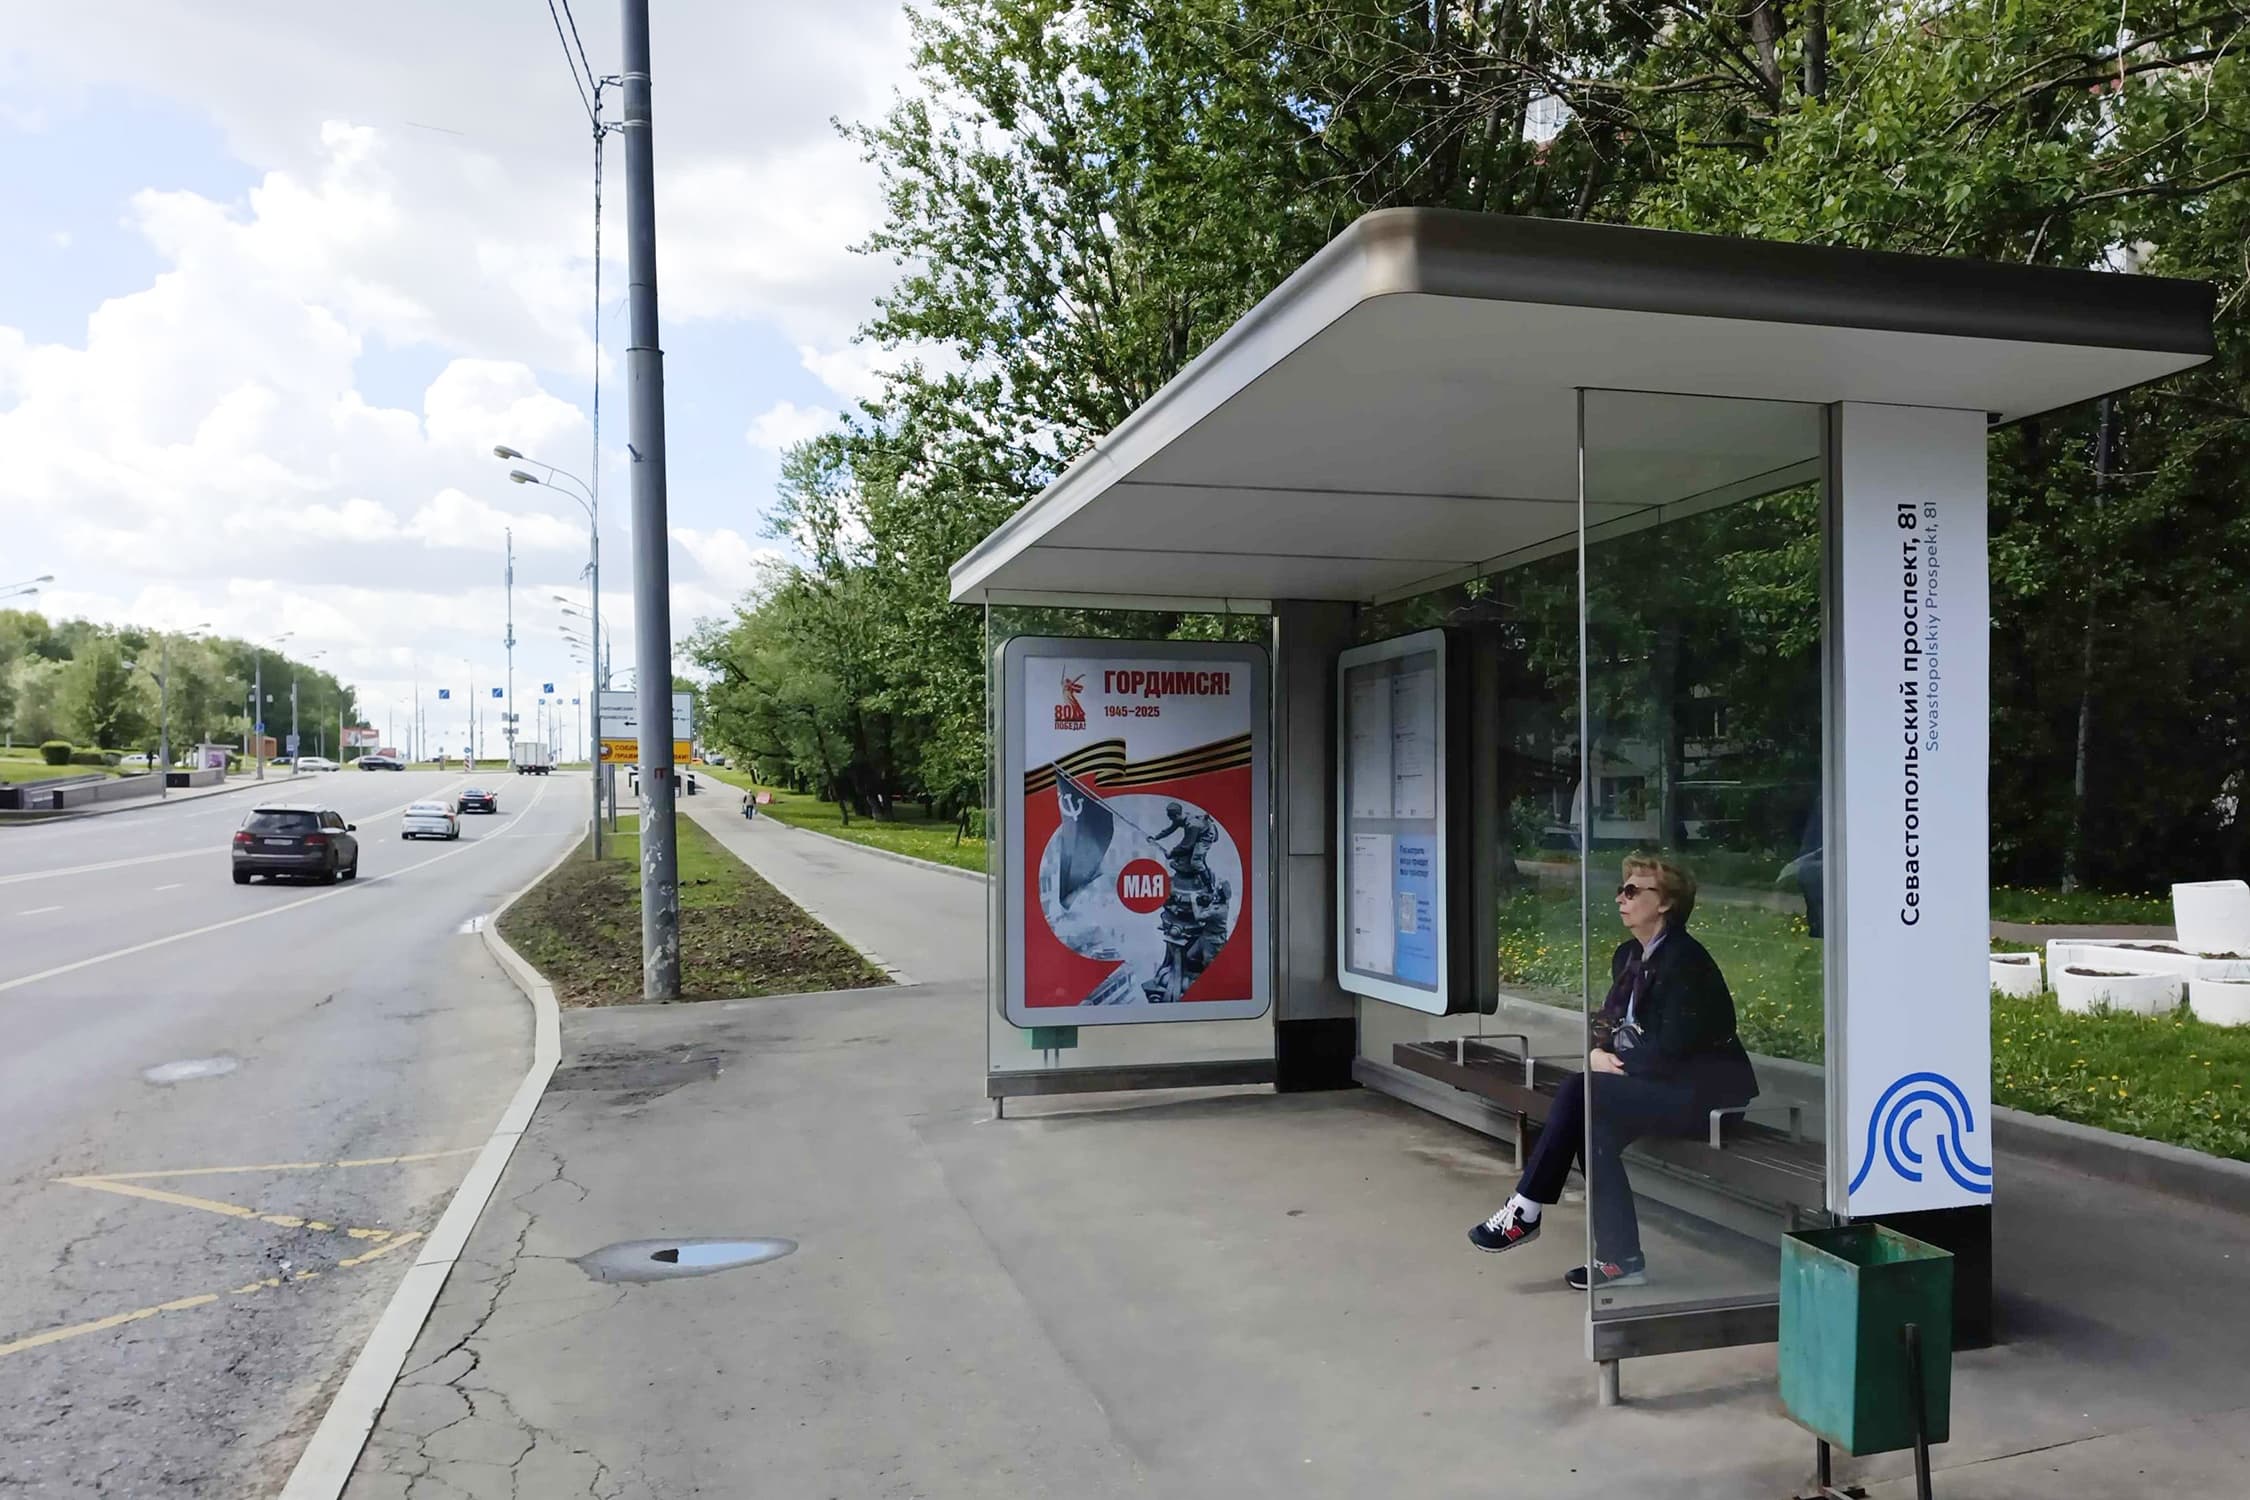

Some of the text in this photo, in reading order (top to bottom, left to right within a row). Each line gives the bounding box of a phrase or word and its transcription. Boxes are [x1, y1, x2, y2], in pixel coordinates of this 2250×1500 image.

[1924, 501, 1941, 752] Sevastopolskiy Prospekt, 81
[1104, 670, 1231, 698] ГОРДИМСЯ!
[1055, 704, 1072, 721] 80
[1898, 503, 1922, 926] Севастопольский проспект, 81
[1054, 722, 1087, 731] ПОБЕДА!
[1123, 875, 1164, 898] МАЯ
